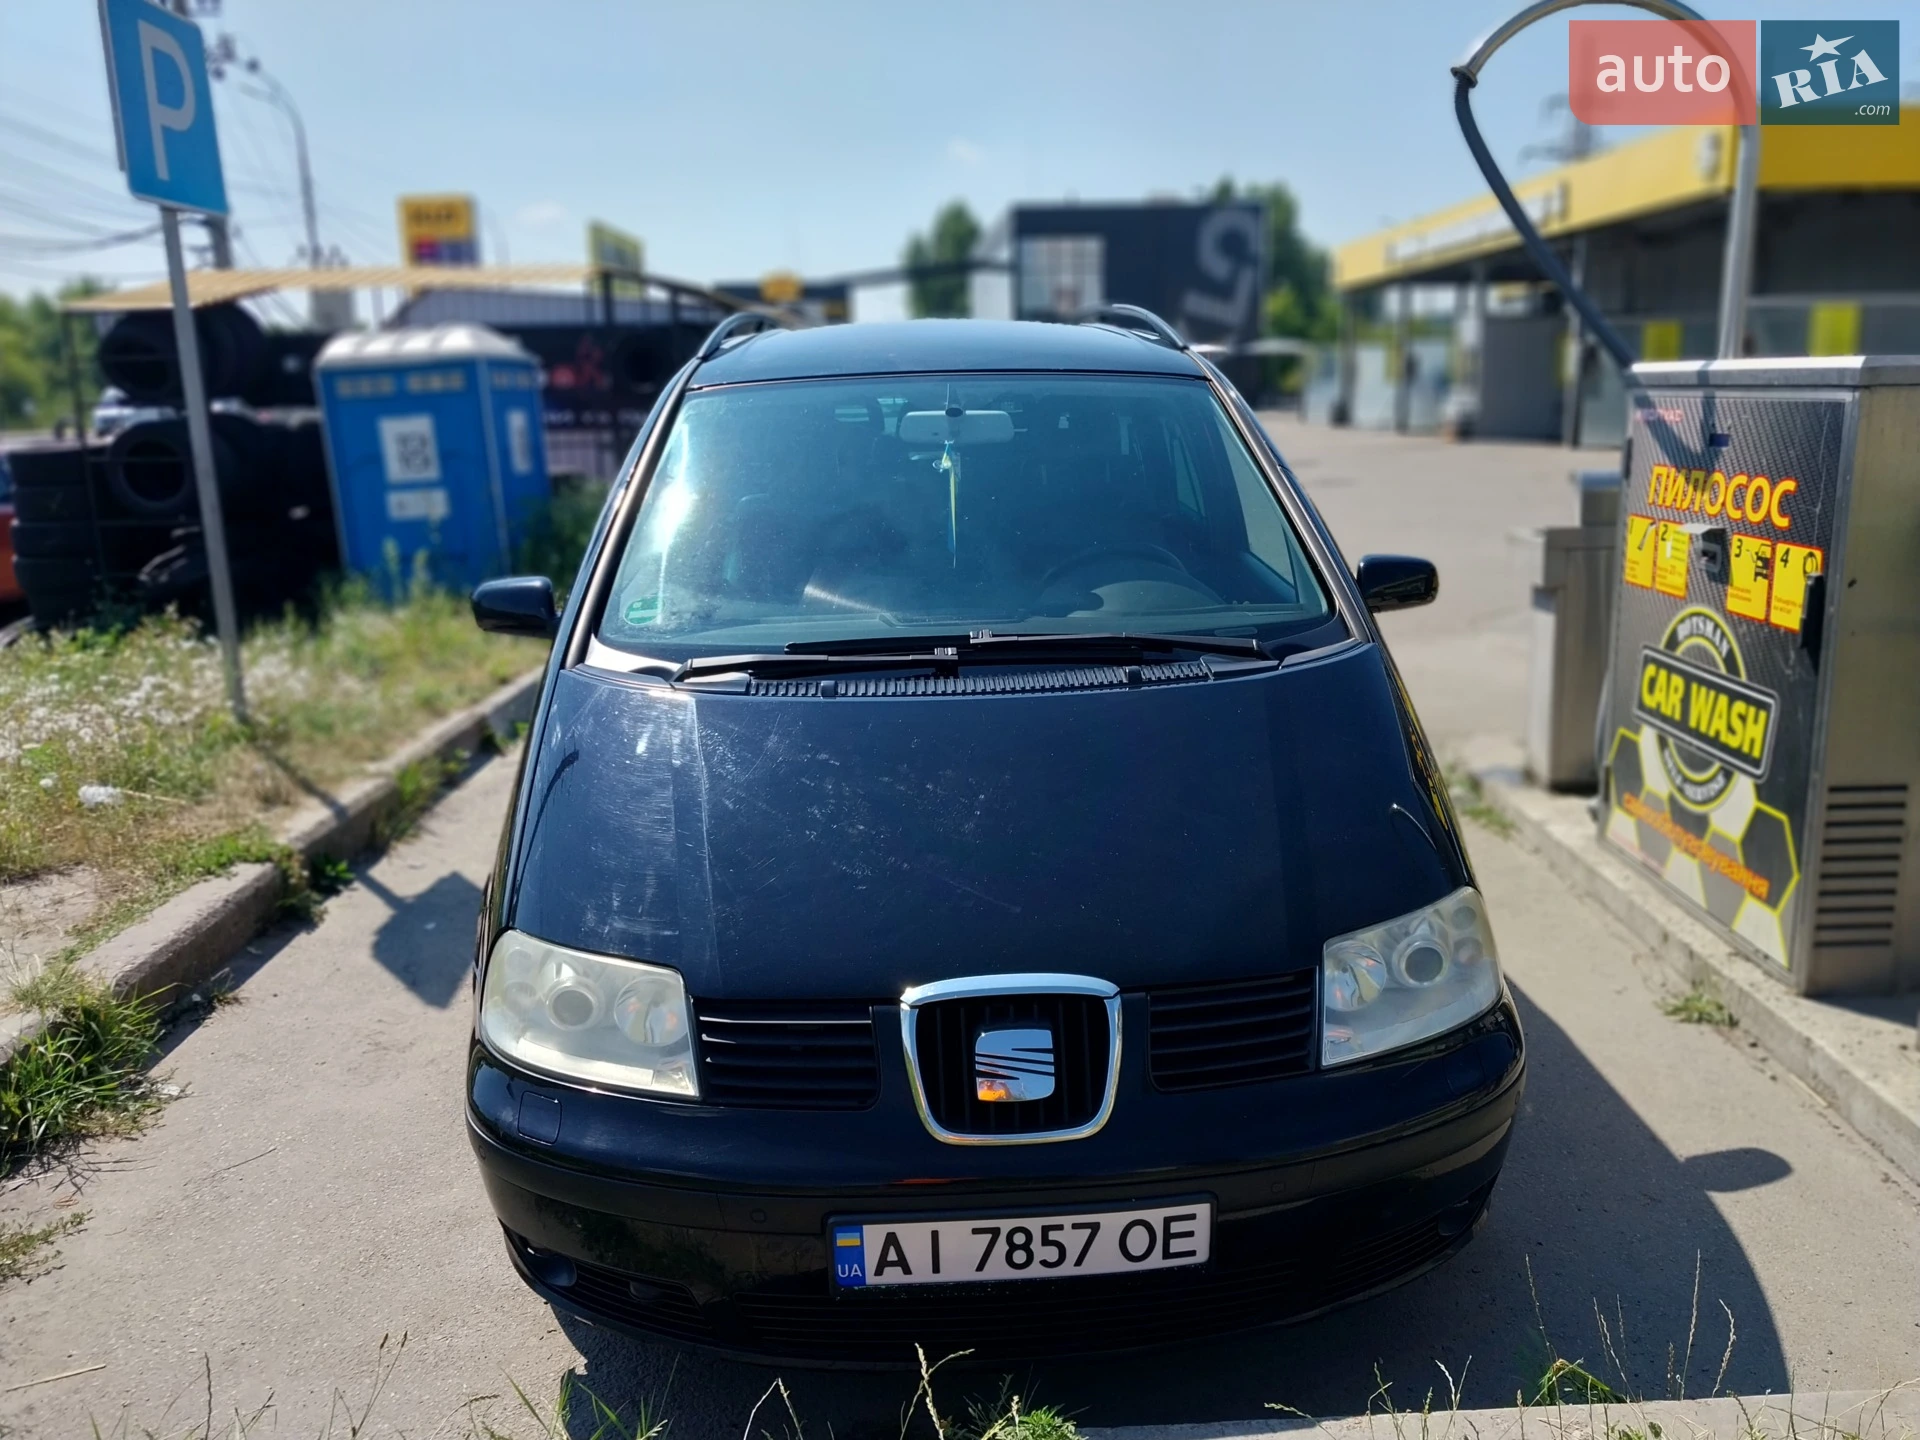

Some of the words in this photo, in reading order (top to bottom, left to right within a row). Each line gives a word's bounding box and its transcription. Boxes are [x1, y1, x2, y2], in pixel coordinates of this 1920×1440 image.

[137, 18, 196, 181] P
[1648, 465, 1798, 528] ПИЛОСОС
[1660, 523, 1669, 541] 2
[1734, 538, 1744, 558] 3
[1780, 547, 1791, 569] 4
[1641, 664, 1685, 721] CAR
[1688, 682, 1768, 760] WASH
[971, 1221, 1101, 1273] 7857
[1118, 1212, 1198, 1264] OE
[837, 1264, 863, 1279] UA
